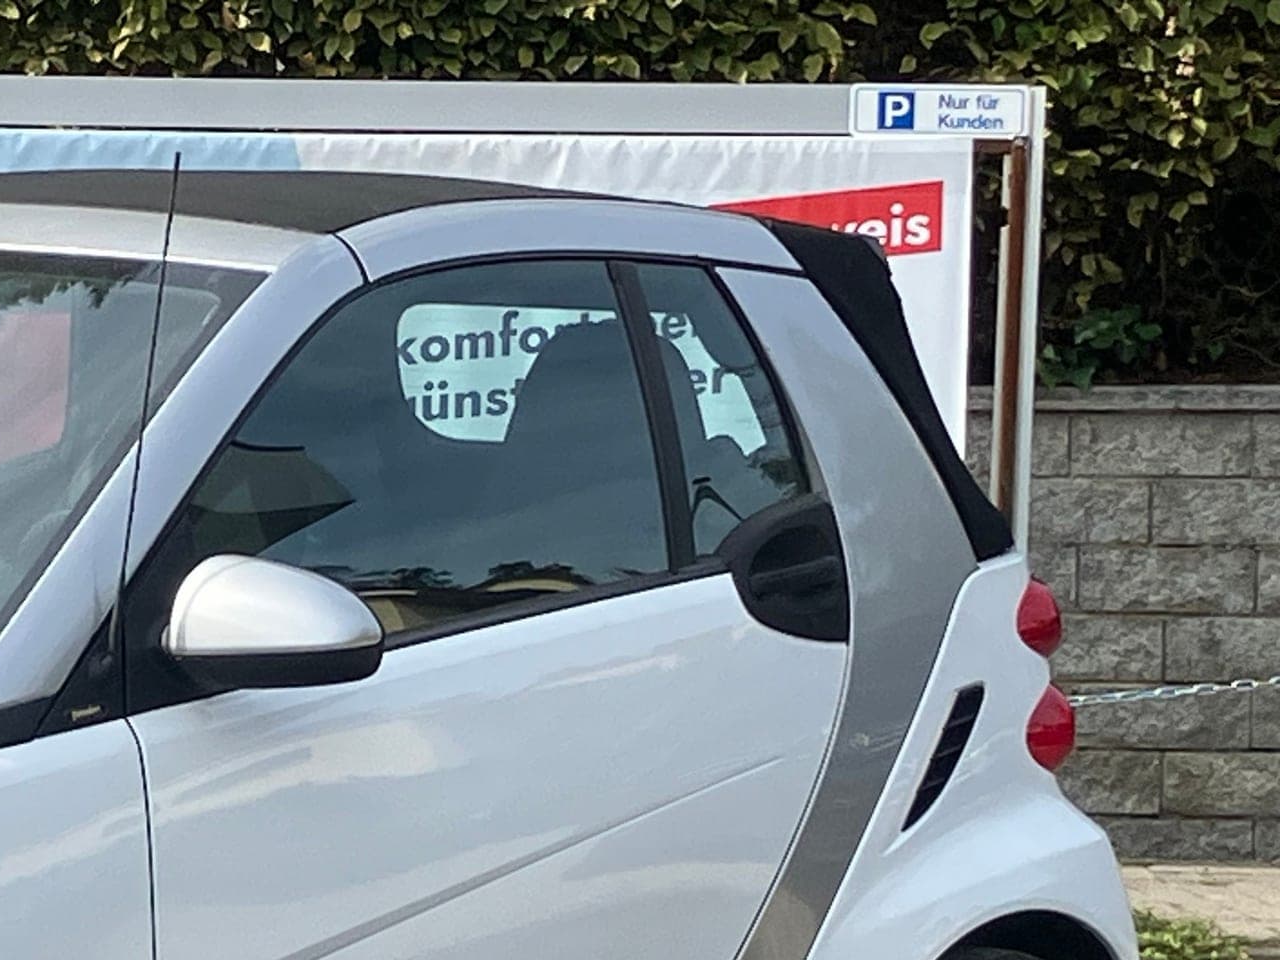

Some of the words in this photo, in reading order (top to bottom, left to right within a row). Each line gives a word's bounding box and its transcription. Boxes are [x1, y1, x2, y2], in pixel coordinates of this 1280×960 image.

[938, 94, 970, 110] Nur
[975, 94, 1000, 111] für
[884, 95, 910, 128] P
[938, 114, 1004, 130] Kunden
